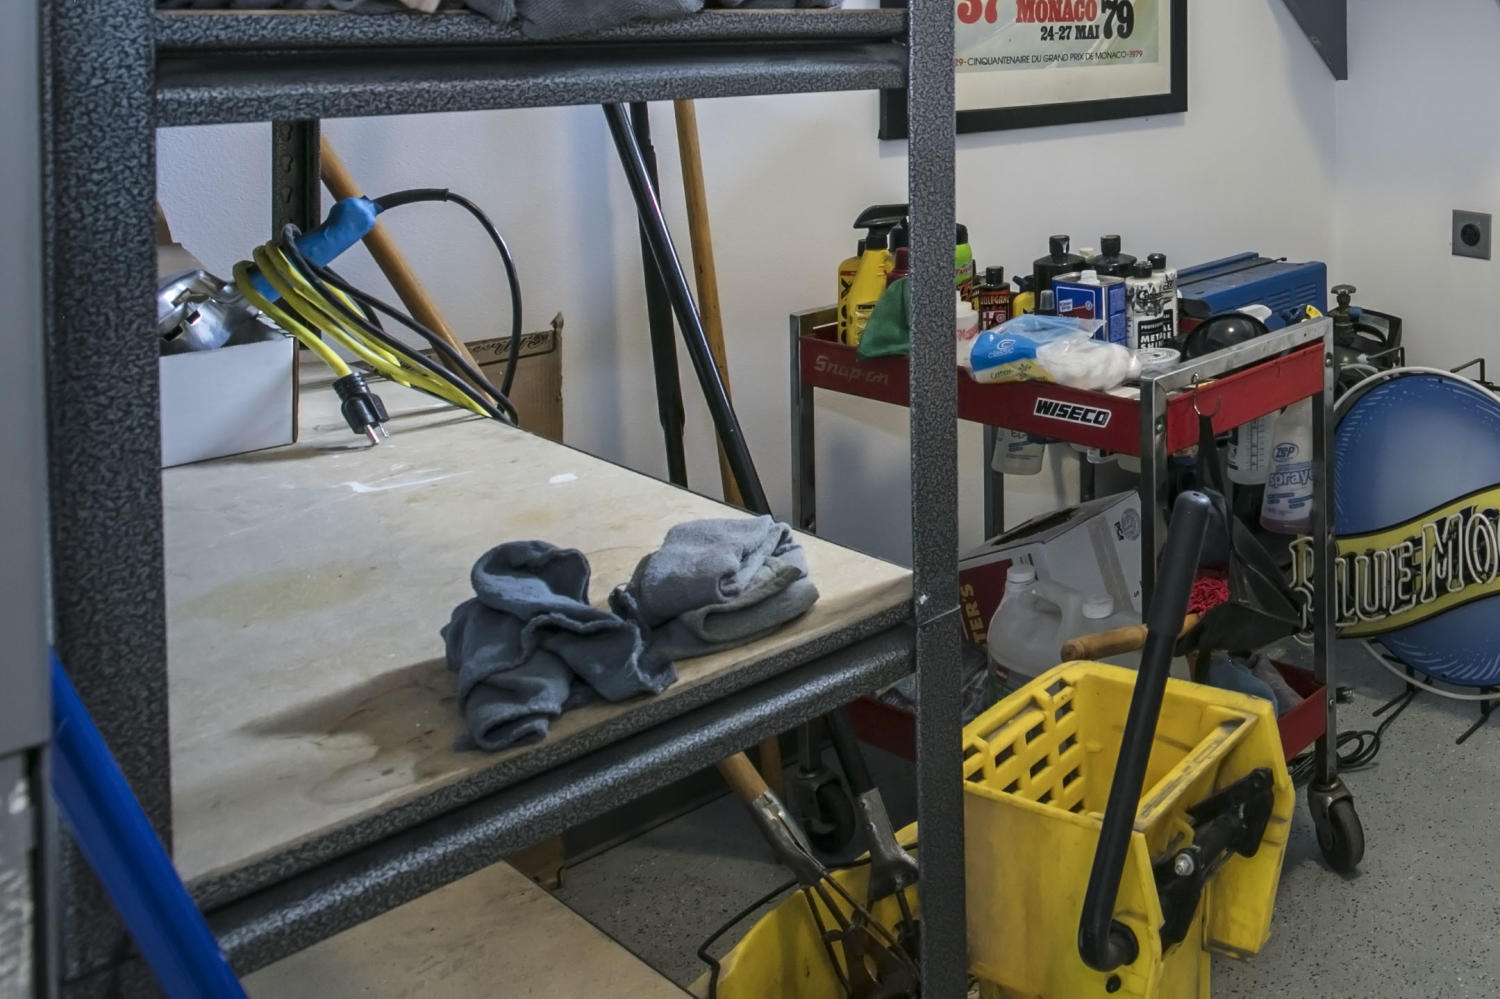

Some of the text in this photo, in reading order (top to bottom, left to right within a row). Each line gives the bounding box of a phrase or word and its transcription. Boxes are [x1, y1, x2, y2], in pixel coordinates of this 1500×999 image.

[1015, 0, 1135, 39] MONACO 79
[1040, 25, 1100, 41] 24-27 MAI
[1031, 55, 1042, 64] DU
[1043, 53, 1069, 63] GRAND
[1070, 52, 1084, 62] PRIX
[1085, 52, 1094, 61] DE
[1035, 399, 1110, 426] WISECO
[1275, 446, 1296, 459] ZEP
